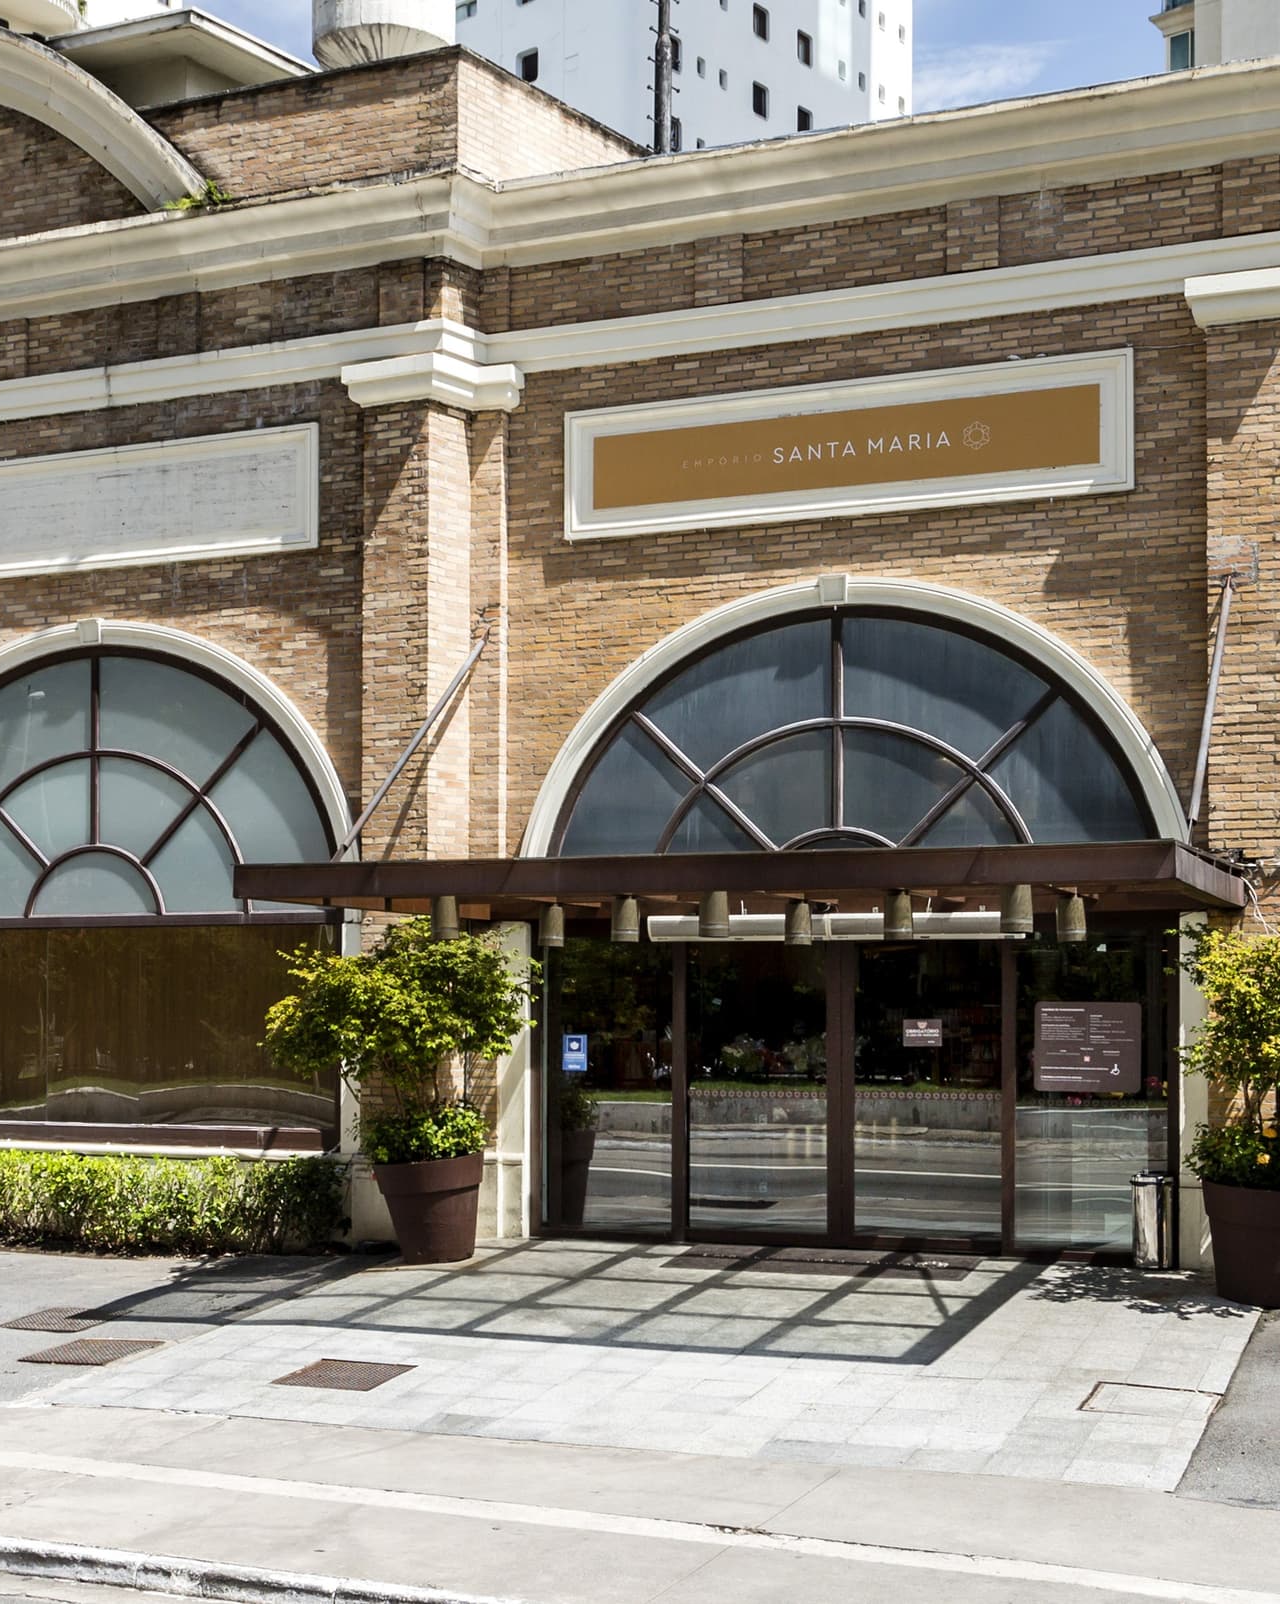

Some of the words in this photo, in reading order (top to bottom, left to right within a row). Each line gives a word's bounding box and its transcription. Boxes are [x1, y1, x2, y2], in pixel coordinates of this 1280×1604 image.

[681, 453, 762, 469] EMPÓRIO
[773, 440, 856, 464] SANTA
[867, 430, 951, 455] MARIA
